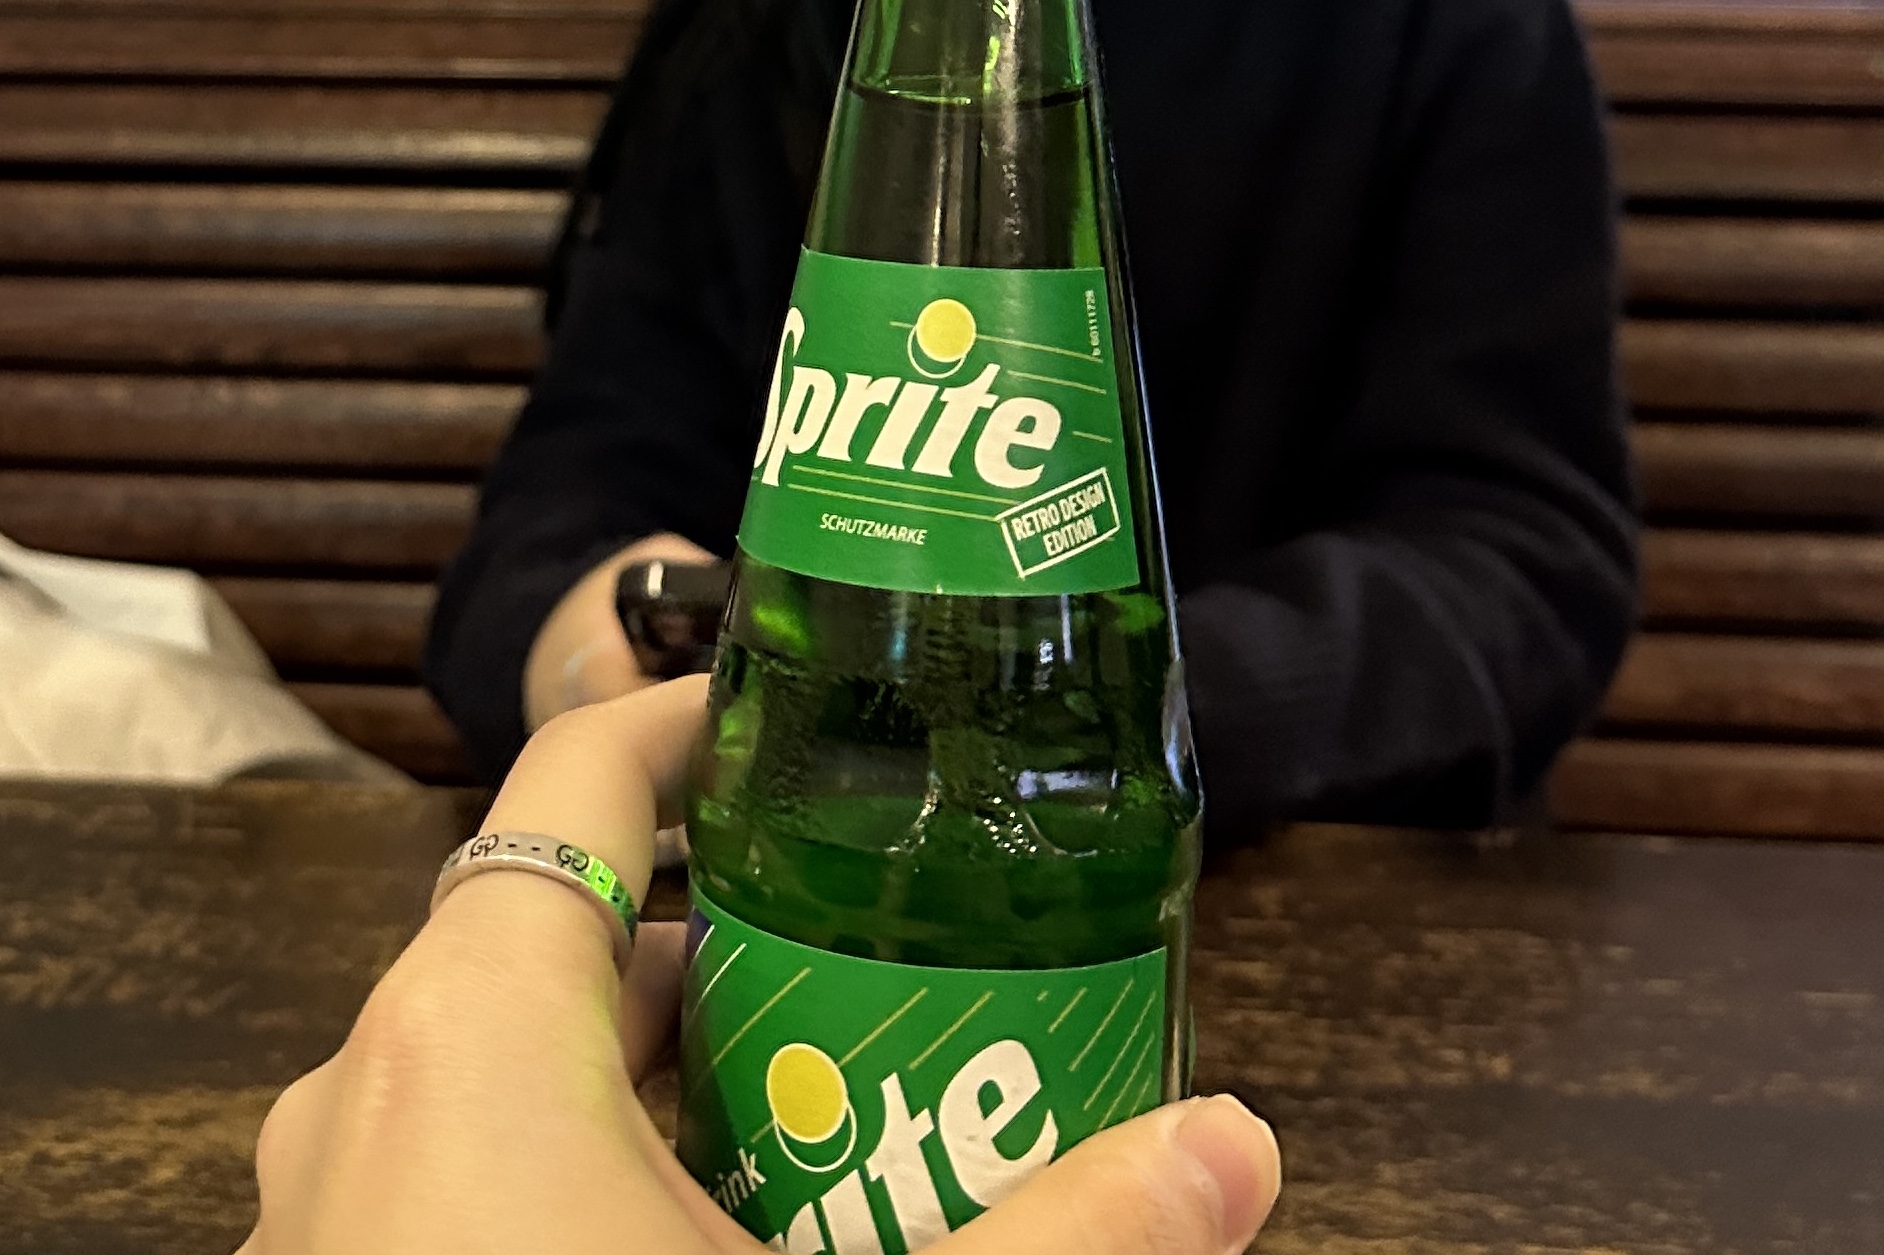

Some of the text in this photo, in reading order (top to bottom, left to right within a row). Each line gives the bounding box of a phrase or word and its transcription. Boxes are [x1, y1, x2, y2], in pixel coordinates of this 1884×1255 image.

[754, 306, 1062, 489] Sprite
[819, 513, 928, 546] SCHUTZMARKE
[1011, 481, 1106, 541] RETRO DESIGN
[1043, 514, 1098, 557] EDITION
